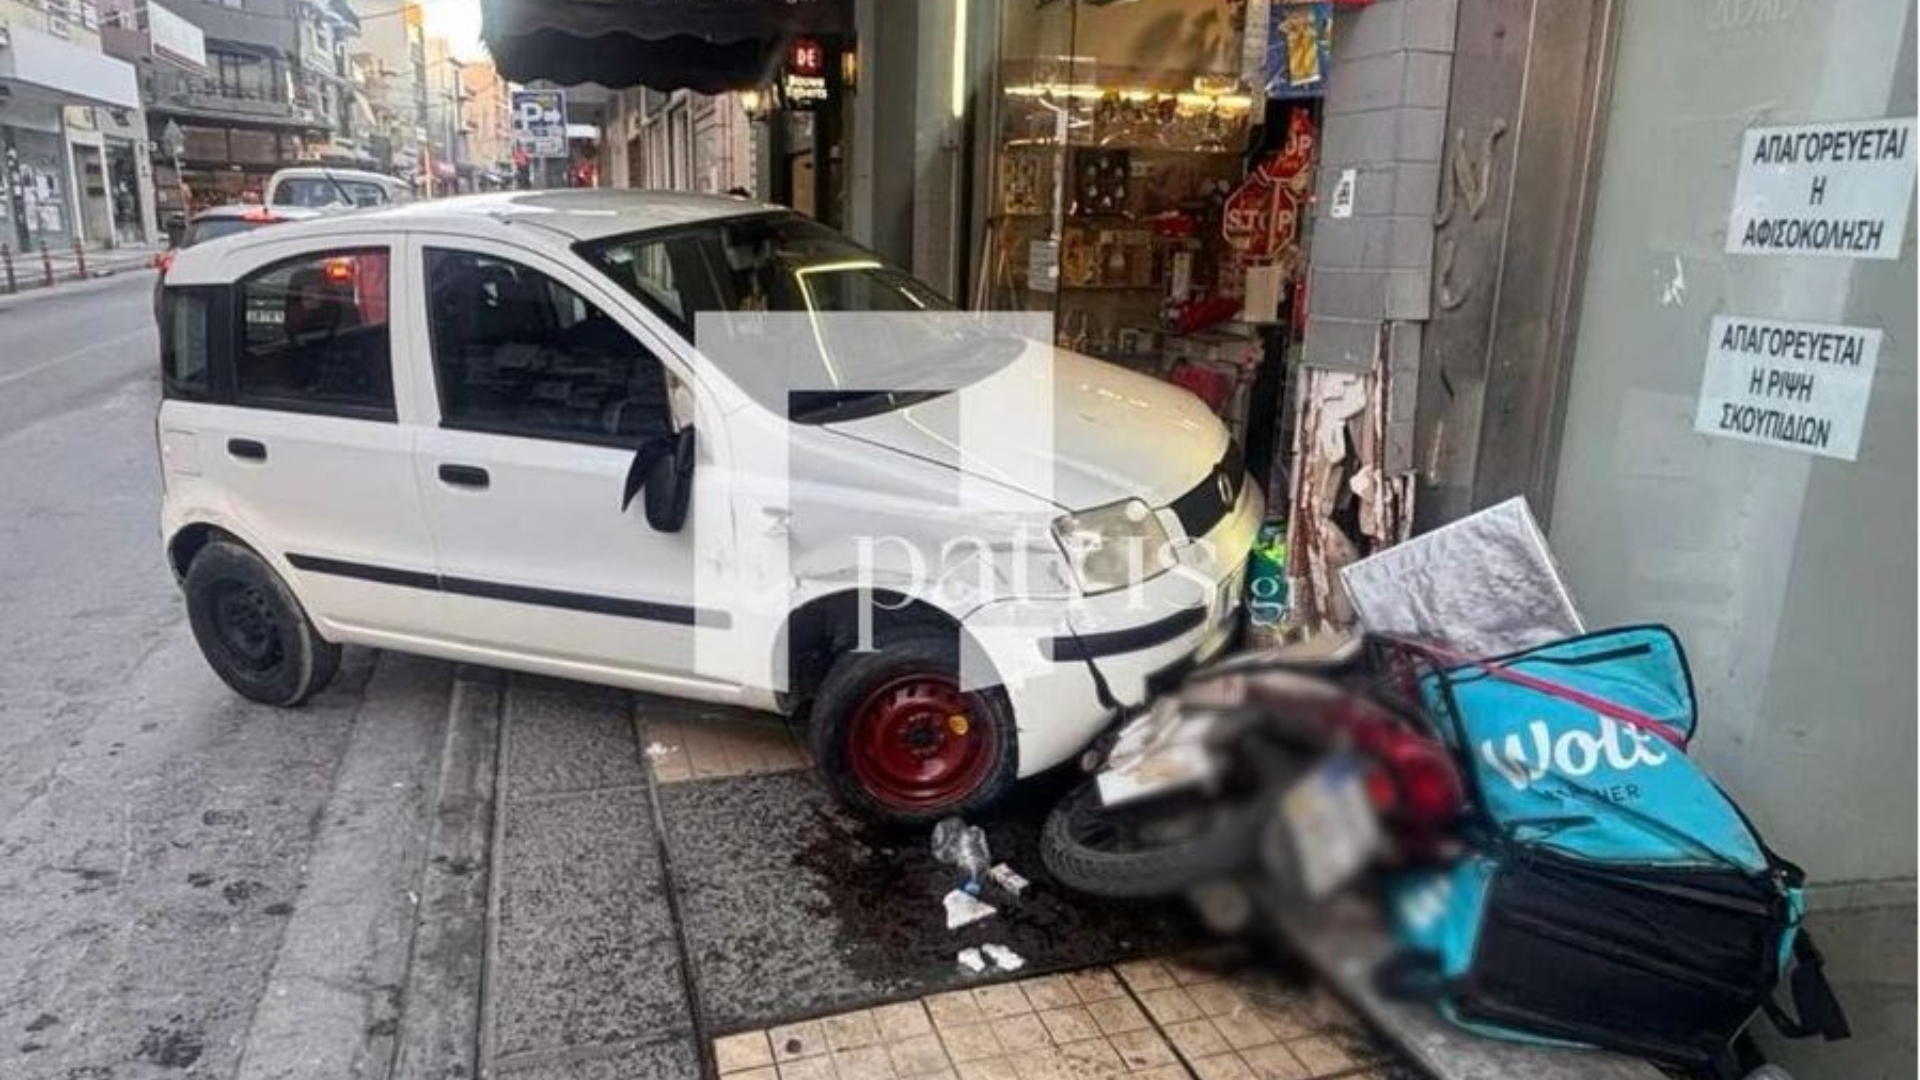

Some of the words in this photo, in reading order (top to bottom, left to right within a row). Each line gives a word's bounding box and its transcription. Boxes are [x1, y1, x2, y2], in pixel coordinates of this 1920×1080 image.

[796, 47, 815, 67] DE
[1753, 128, 1908, 165] ΑΠΑΓΟΡΕΥΕΤΑΙ
[1809, 175, 1827, 205] Η
[1742, 219, 1884, 251] ΑΦΙΣΟΚΟΛΗΣΗ
[1721, 324, 1865, 366] ΑΠΑΓΟΡΕΥΕΤΑΙ
[1749, 366, 1765, 395] Η
[1766, 369, 1815, 403] ΡΙΨΗ
[1719, 402, 1832, 448] ΣΚΟΥΠΙΔΙΩΝ
